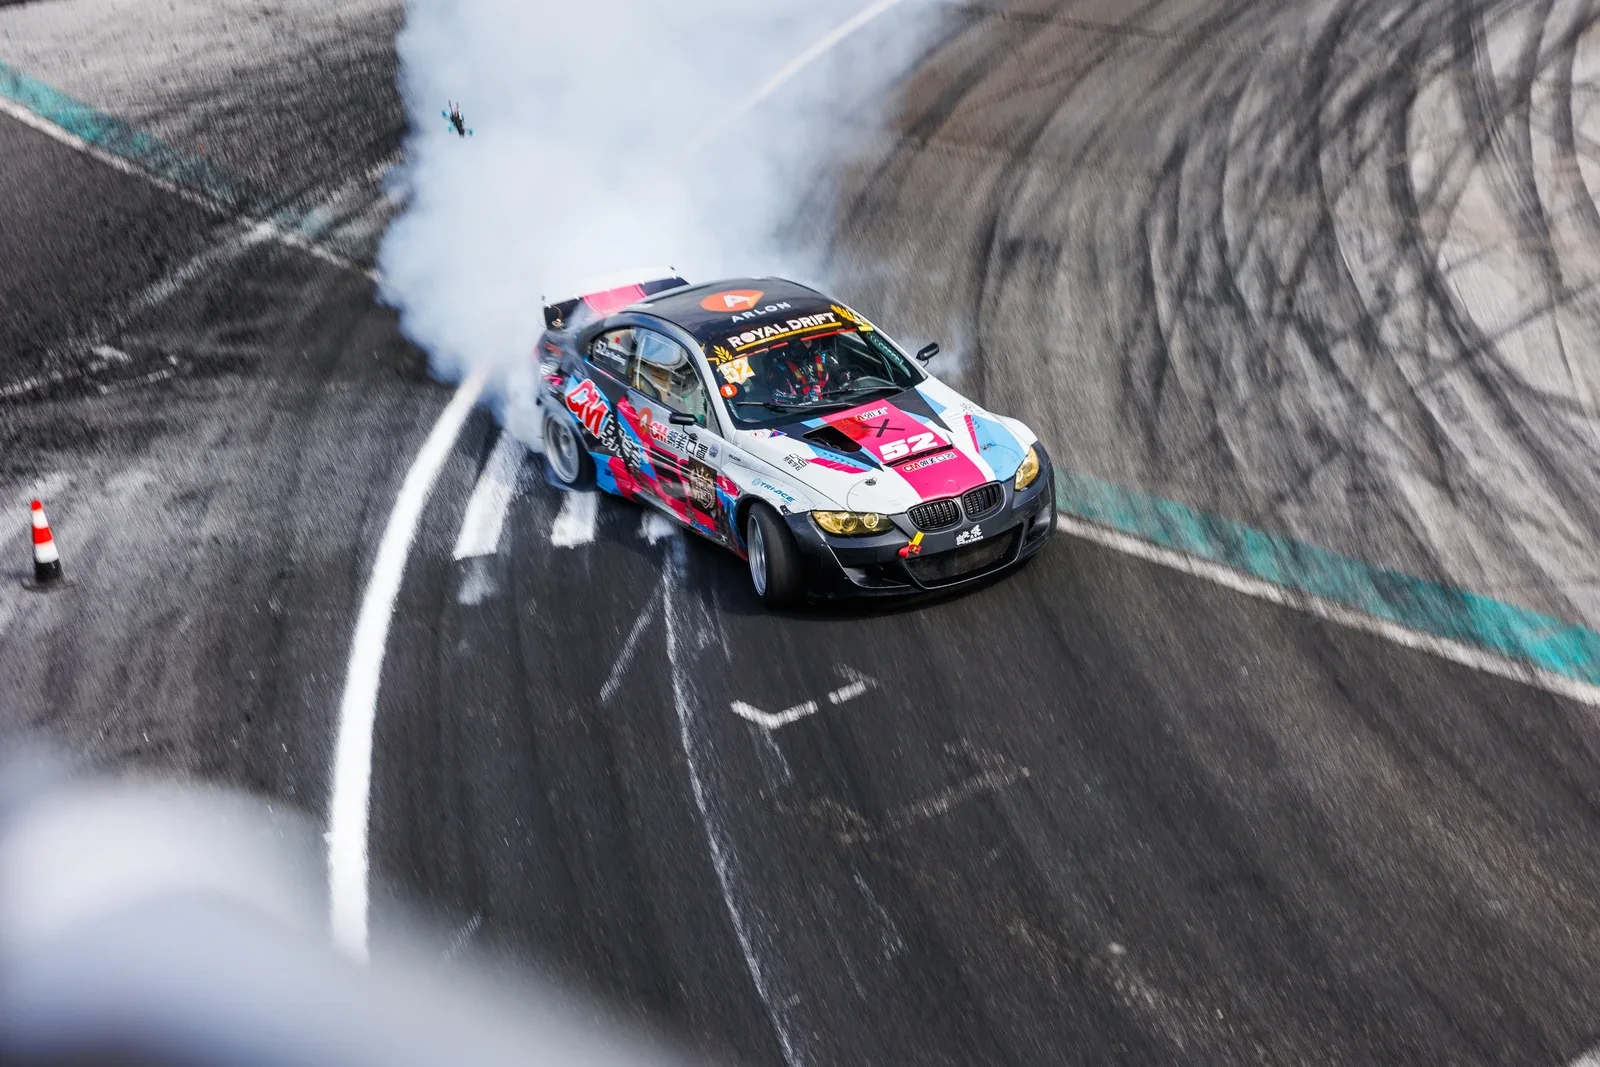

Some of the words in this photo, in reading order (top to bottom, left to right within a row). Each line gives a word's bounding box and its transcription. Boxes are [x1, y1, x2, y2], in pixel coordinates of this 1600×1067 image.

[731, 302, 792, 323] ARLON
[727, 323, 790, 349] ROYAL
[786, 312, 837, 331] DRIFT
[719, 359, 754, 383] 52
[723, 385, 734, 397] B
[565, 378, 609, 439] CM
[878, 432, 939, 461] 52
[758, 481, 797, 504] TRI-ACE
